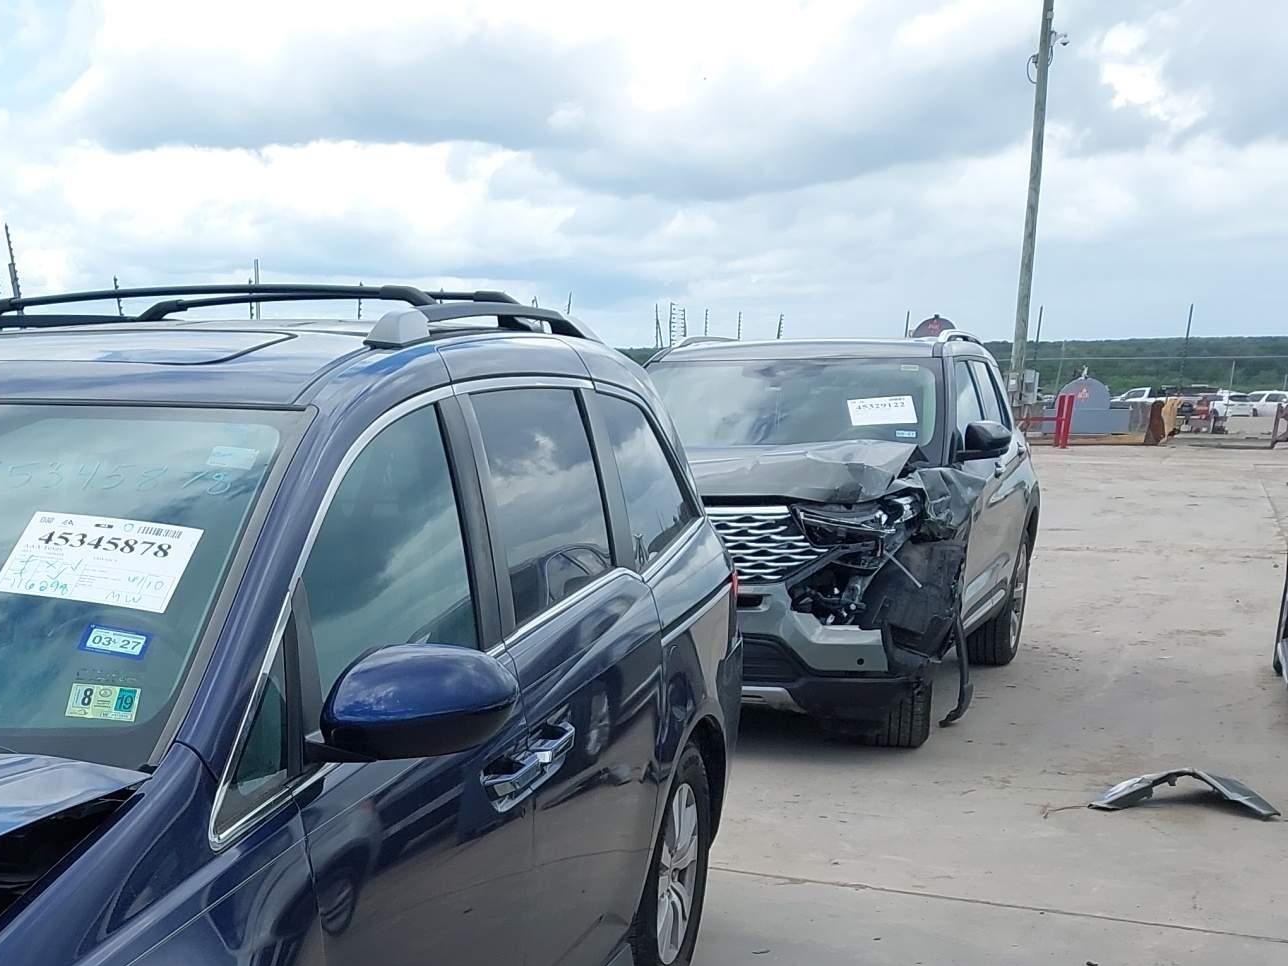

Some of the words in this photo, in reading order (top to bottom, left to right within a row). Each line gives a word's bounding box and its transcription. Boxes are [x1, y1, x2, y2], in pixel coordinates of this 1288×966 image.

[38, 530, 173, 559] 45345878
[92, 635, 112, 647] 03
[119, 639, 142, 650] 27
[81, 687, 94, 706] 8
[117, 694, 134, 710] 19
